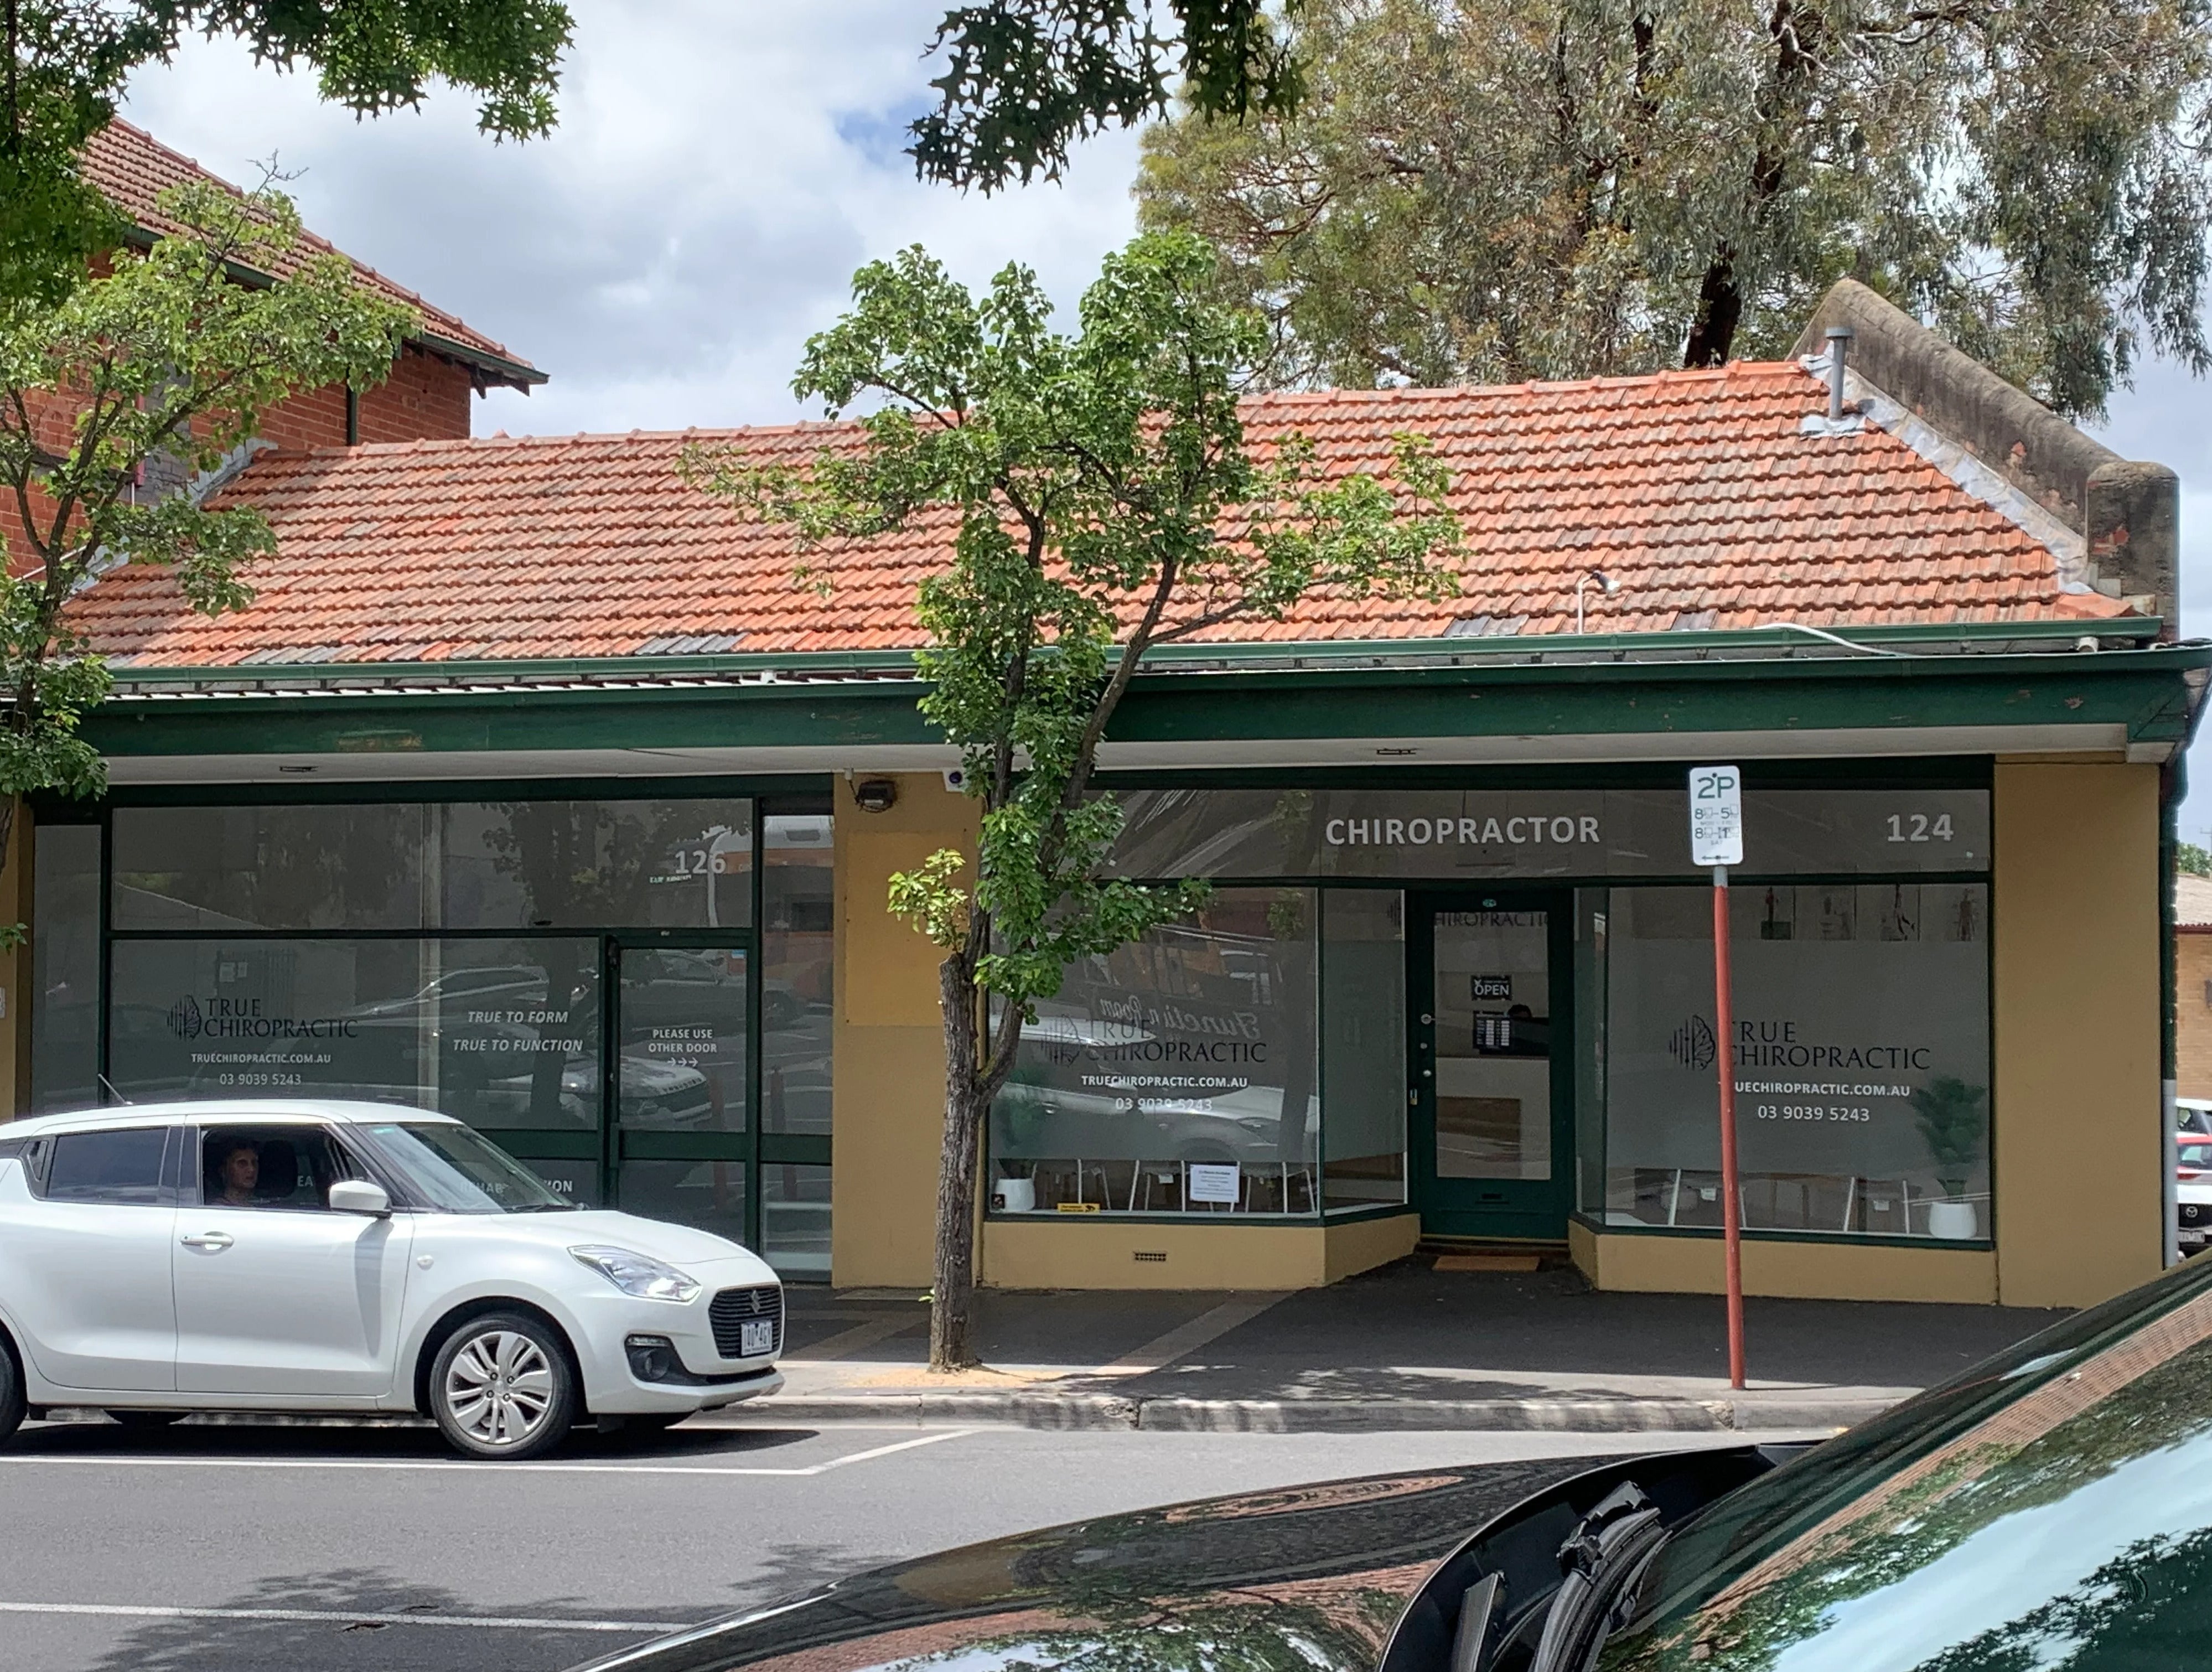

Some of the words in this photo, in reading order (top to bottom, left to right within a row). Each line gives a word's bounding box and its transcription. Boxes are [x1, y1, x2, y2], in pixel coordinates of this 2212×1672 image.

[1697, 777, 1735, 798] 2P
[1325, 817, 1600, 845] CHIROPRACTOR
[1887, 814, 1954, 841] 124
[675, 850, 726, 874] 126
[1474, 984, 1509, 996] OPEN
[205, 998, 261, 1017] TRUE
[468, 1011, 502, 1023] TRUE
[506, 1011, 524, 1023] TO
[528, 1011, 568, 1023] FORM
[204, 1019, 359, 1038] CHIROPRACTIC
[652, 1029, 690, 1038] PLEASE
[693, 1029, 713, 1038] USE
[1086, 1019, 1151, 1039] TRUE
[1732, 1021, 1796, 1042] RUE
[453, 1039, 488, 1051] TRUE
[492, 1039, 509, 1051] TO
[513, 1039, 583, 1051] FUNCTION
[649, 1043, 683, 1053] OTHER
[686, 1043, 717, 1053] DOOR
[1087, 1042, 1267, 1062] CHIROPRACTIC
[191, 1054, 331, 1063] TRUECHIROPRACTIC.COM.AU
[220, 1074, 234, 1085] 03
[238, 1074, 267, 1085] 9039
[272, 1074, 301, 1085] 5243
[1081, 1075, 1247, 1088] TRUECHIROPRACTIC.COM.AU
[1734, 1082, 1910, 1096] UECHIROPRACTIC.COM.AU
[1115, 1098, 1133, 1109] 03
[1178, 1099, 1212, 1111] 5243
[1758, 1105, 1777, 1119] 03
[1783, 1106, 1824, 1120] 9039
[1830, 1107, 1870, 1122] 5243
